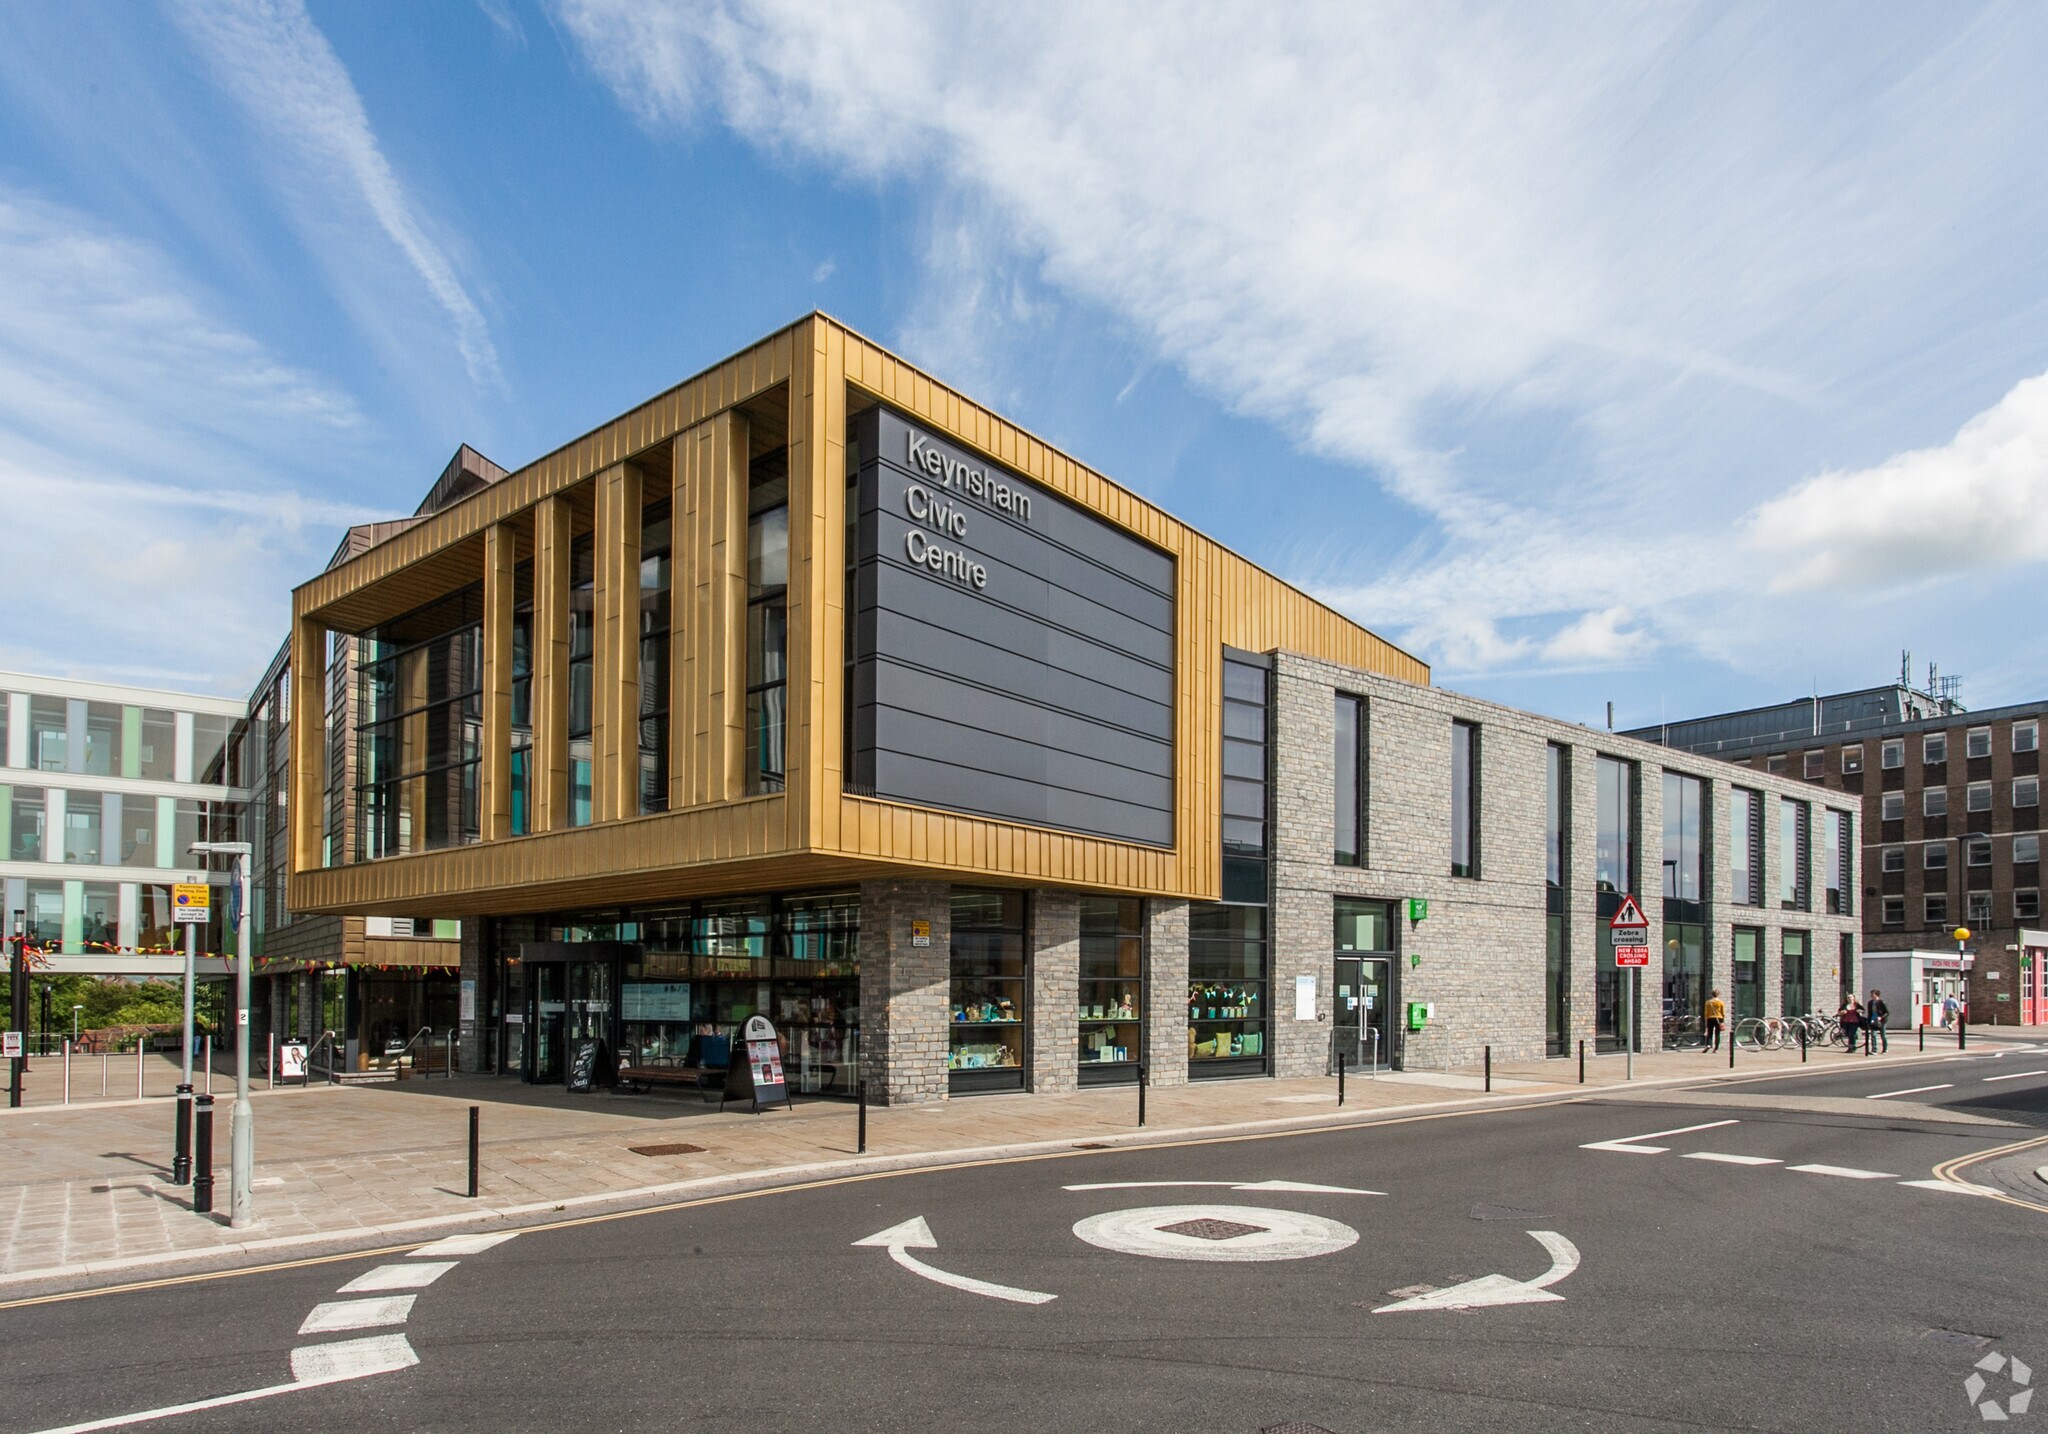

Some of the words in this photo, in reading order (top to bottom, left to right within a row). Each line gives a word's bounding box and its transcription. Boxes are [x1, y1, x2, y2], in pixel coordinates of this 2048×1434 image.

[908, 429, 1031, 519] Keynsham
[907, 485, 967, 536] Civic
[906, 529, 987, 588] Centre
[240, 1013, 247, 1021] 2
